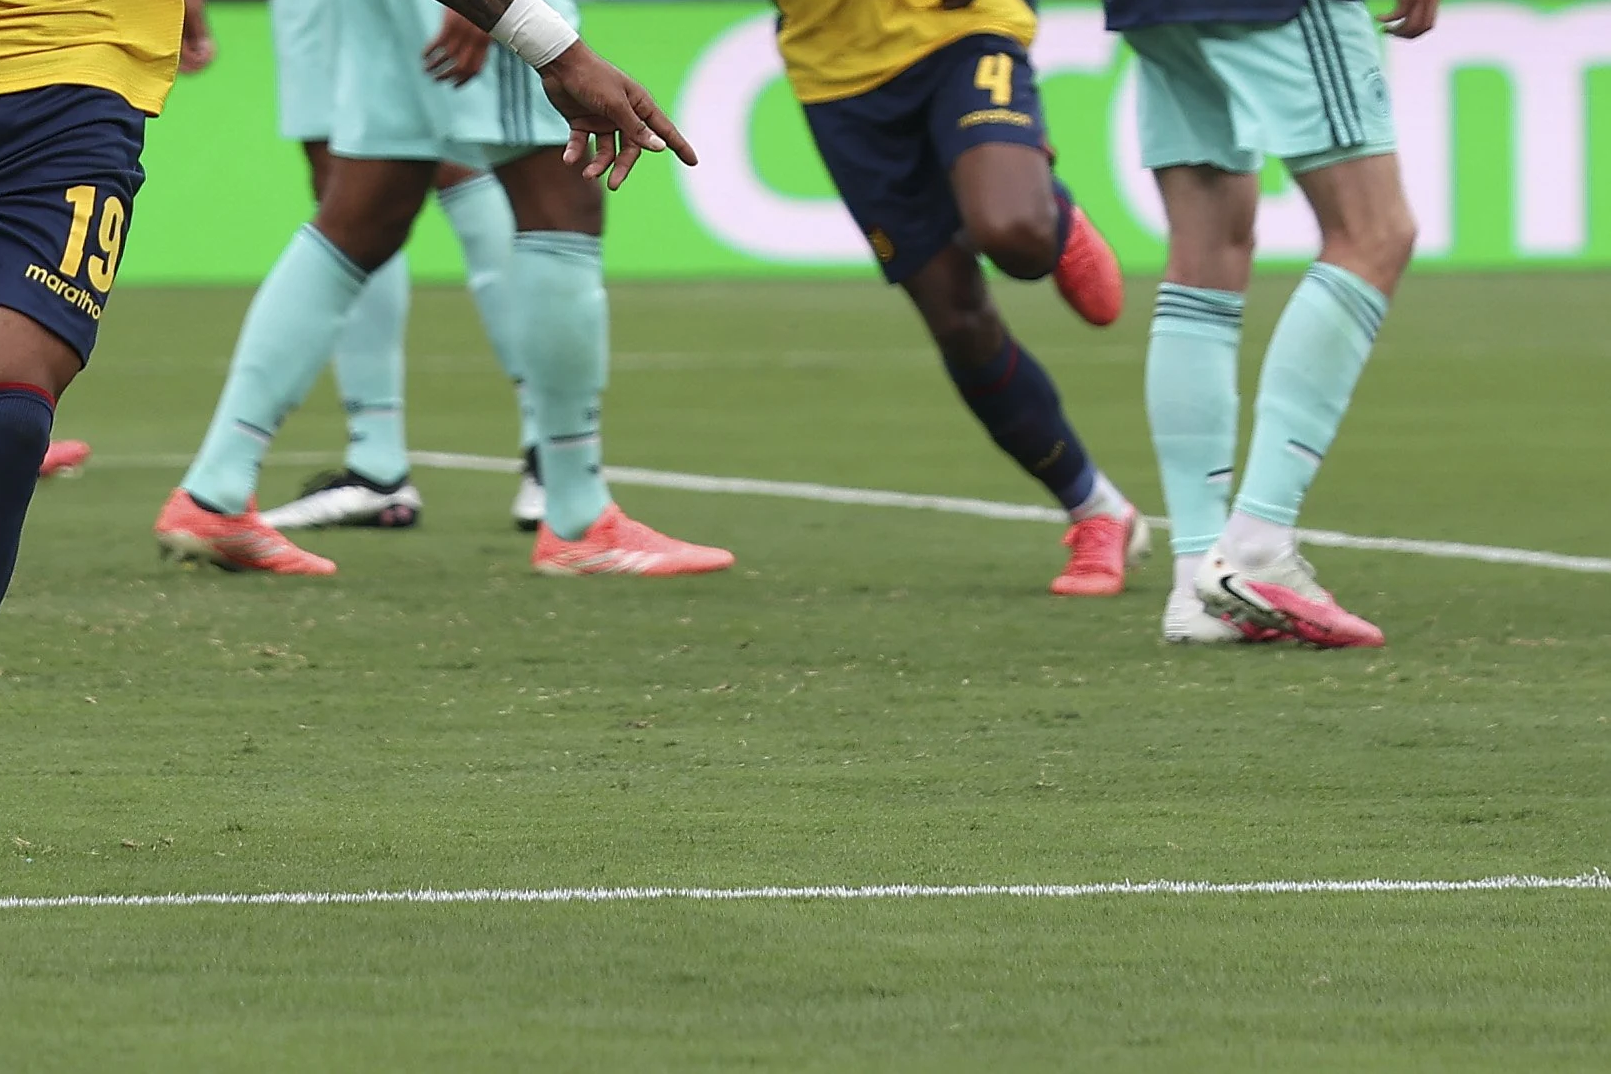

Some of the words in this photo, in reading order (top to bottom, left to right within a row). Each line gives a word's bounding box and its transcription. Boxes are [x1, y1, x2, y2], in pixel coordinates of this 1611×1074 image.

[973, 52, 1013, 106] 4
[59, 185, 124, 293] 19
[25, 263, 101, 319] maratho
